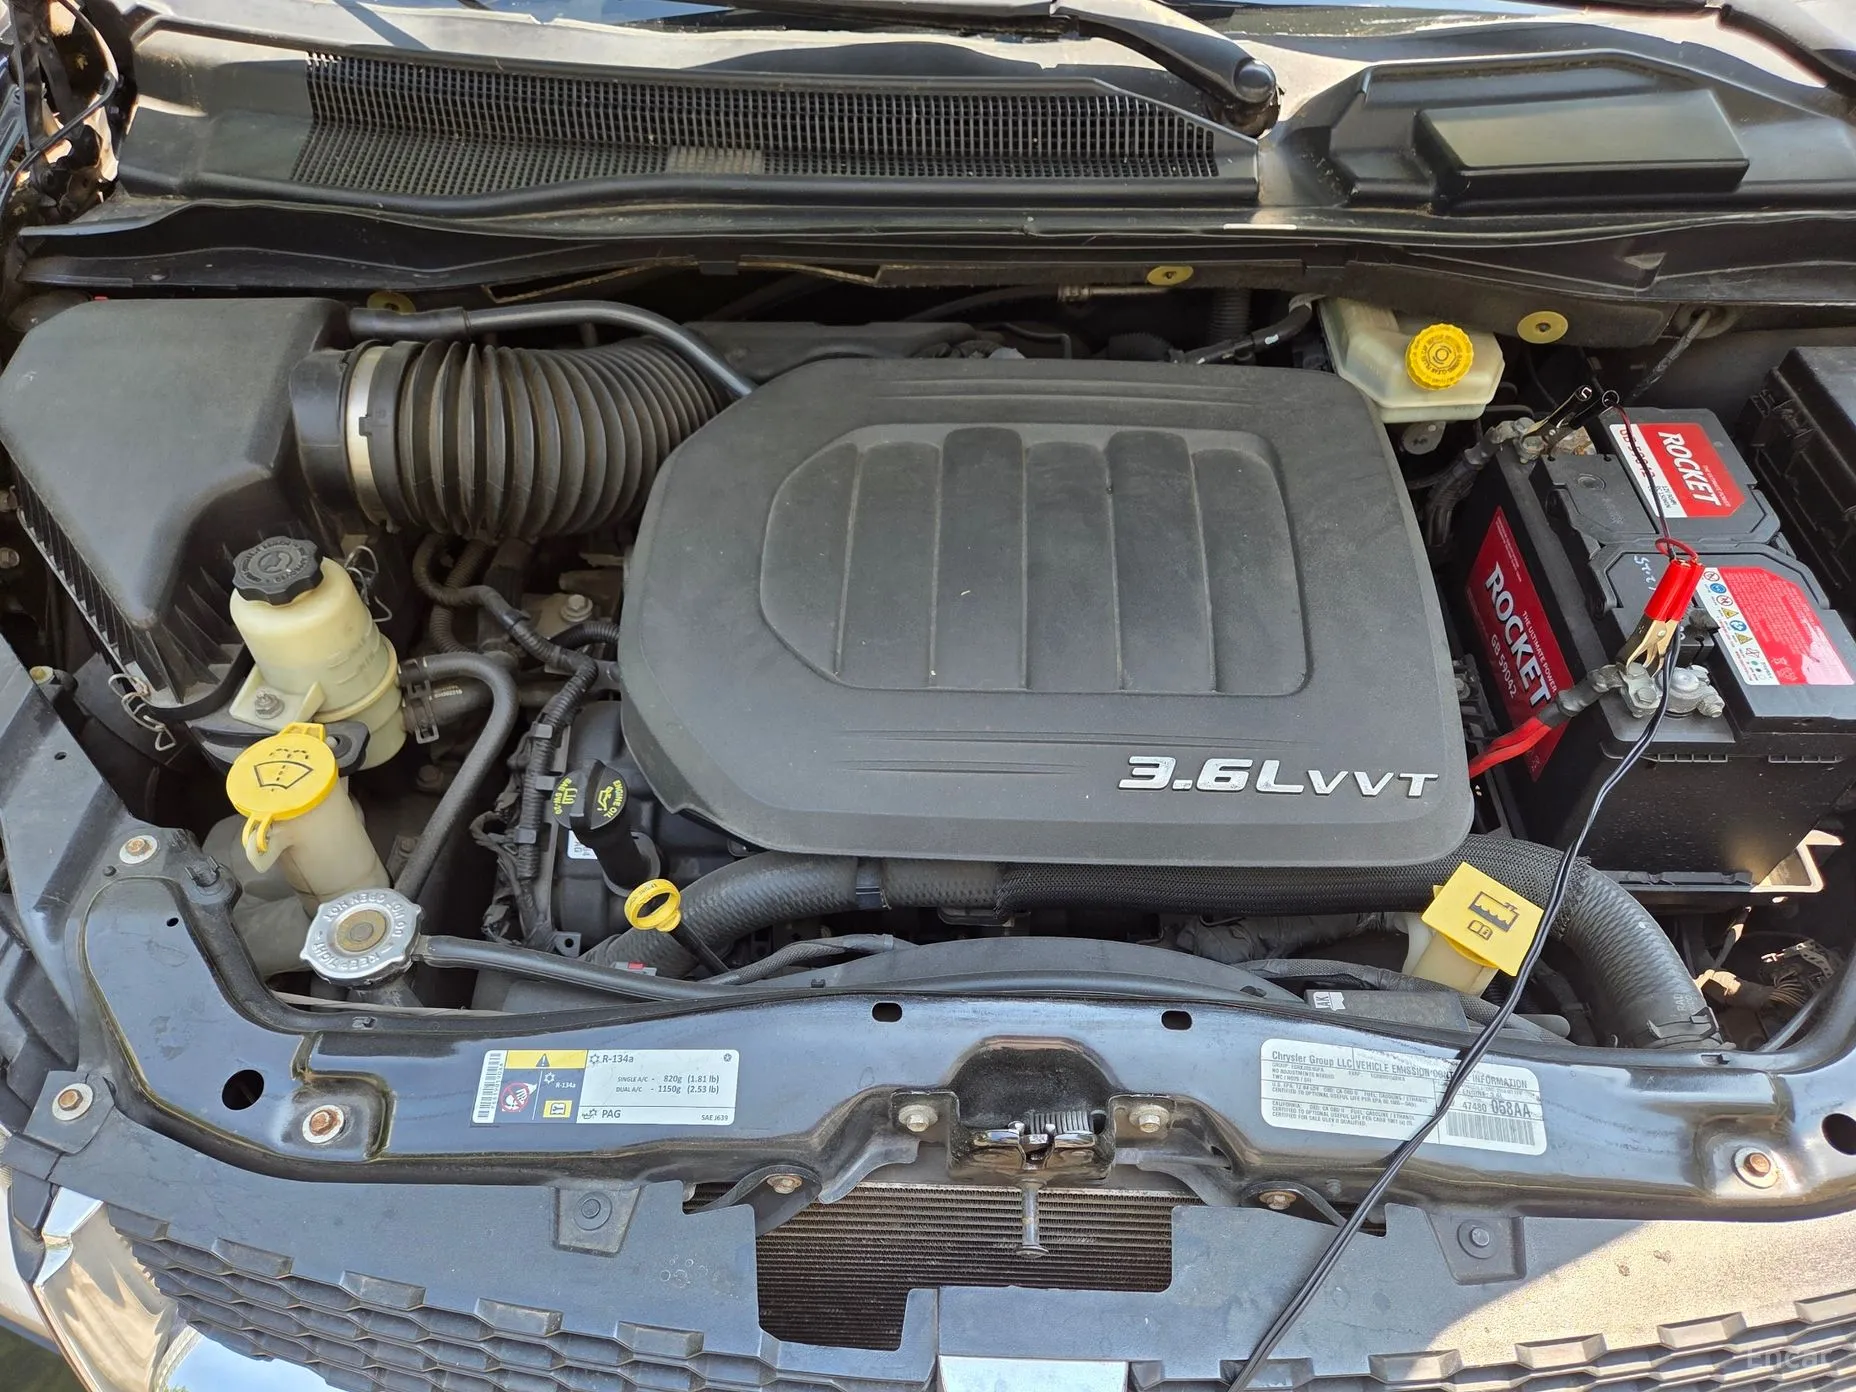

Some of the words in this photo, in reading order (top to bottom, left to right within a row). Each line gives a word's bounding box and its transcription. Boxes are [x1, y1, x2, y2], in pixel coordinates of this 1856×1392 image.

[1658, 432, 1721, 507] ROCKET
[1484, 561, 1552, 710] ROCKET
[1522, 610, 1531, 627] THE
[1527, 626, 1546, 662] ULTIMATE
[1542, 661, 1557, 694] POWER
[1490, 634, 1500, 655] GB
[1498, 656, 1518, 699] 59042
[1118, 756, 1305, 795] 3.6L
[1307, 770, 1439, 798] VVT
[612, 779, 624, 807] ENGINE
[603, 806, 618, 818] OIL
[602, 1054, 634, 1063] R-134a
[1272, 1050, 1306, 1062] Chrysler
[1309, 1055, 1334, 1067] Group
[1337, 1058, 1352, 1068] LLC
[1356, 1060, 1388, 1072] VEHICLE
[1472, 1074, 1528, 1088] INFORMATION
[658, 1085, 681, 1094] 1150g
[687, 1085, 707, 1094] (2.53
[709, 1085, 719, 1094] lb)
[663, 1075, 682, 1084] 820g
[687, 1075, 706, 1084] (1.81
[709, 1075, 720, 1084] lb)
[602, 1109, 621, 1118] PAG
[1462, 1102, 1487, 1112] 47480
[1491, 1100, 1532, 1118] 058AA
